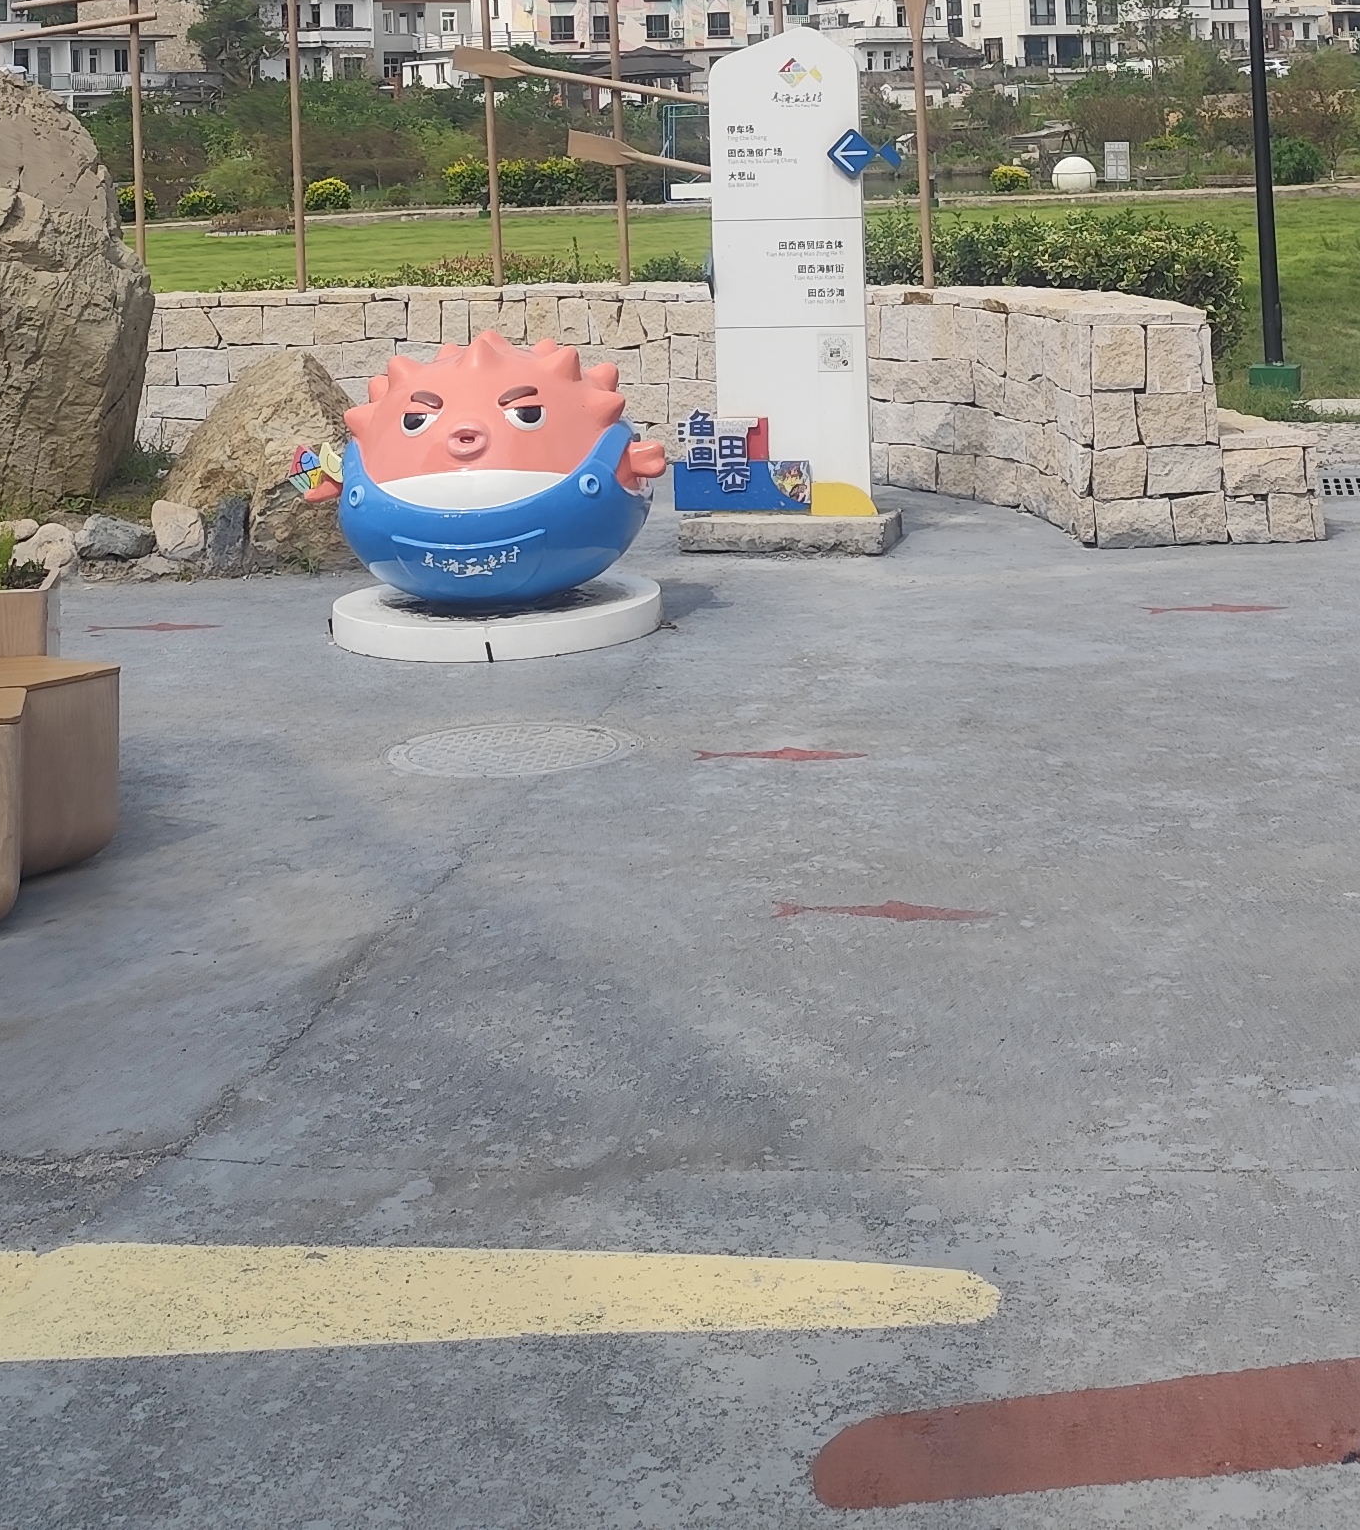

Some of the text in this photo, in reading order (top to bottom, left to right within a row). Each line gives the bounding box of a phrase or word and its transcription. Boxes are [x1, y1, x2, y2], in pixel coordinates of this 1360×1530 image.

[727, 125, 754, 134] 停车场
[717, 436, 750, 490] 田岙
